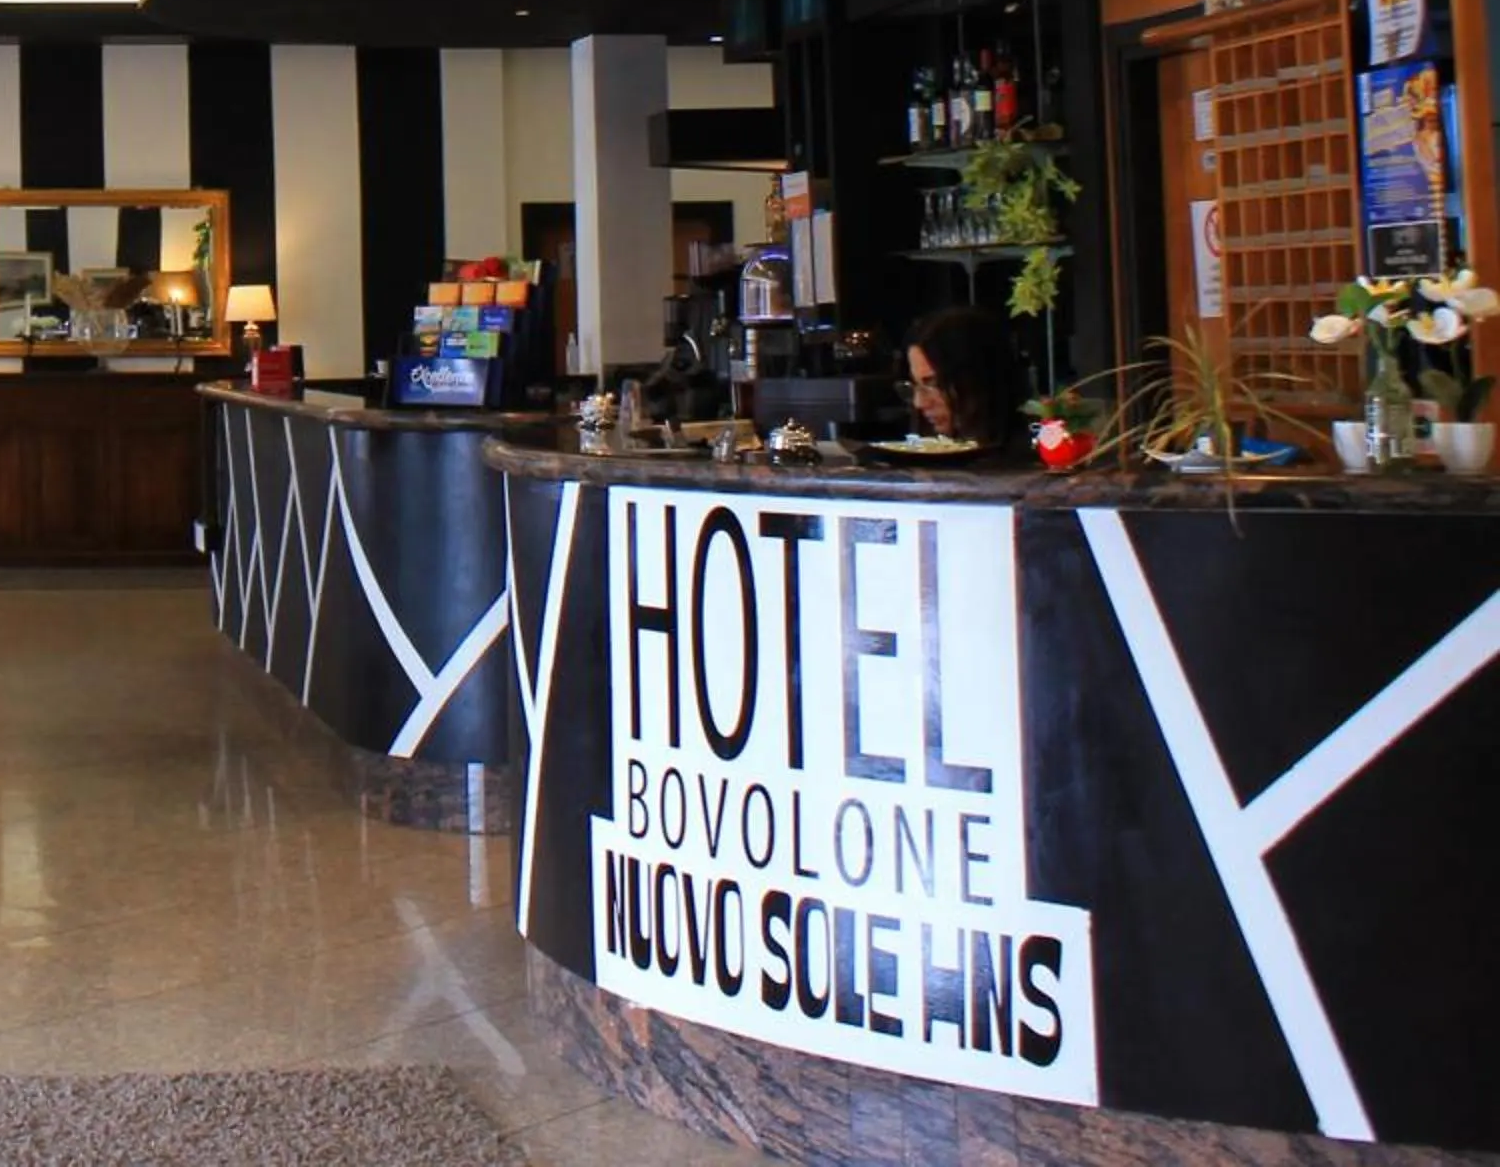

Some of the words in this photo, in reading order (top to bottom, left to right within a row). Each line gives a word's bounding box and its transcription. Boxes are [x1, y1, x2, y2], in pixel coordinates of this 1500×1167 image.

[627, 502, 993, 794] HOTEL
[628, 759, 993, 906] BOVOLONE
[606, 849, 745, 997] NUOVO
[760, 889, 904, 1039] SOLE
[921, 922, 1063, 1068] HNS
